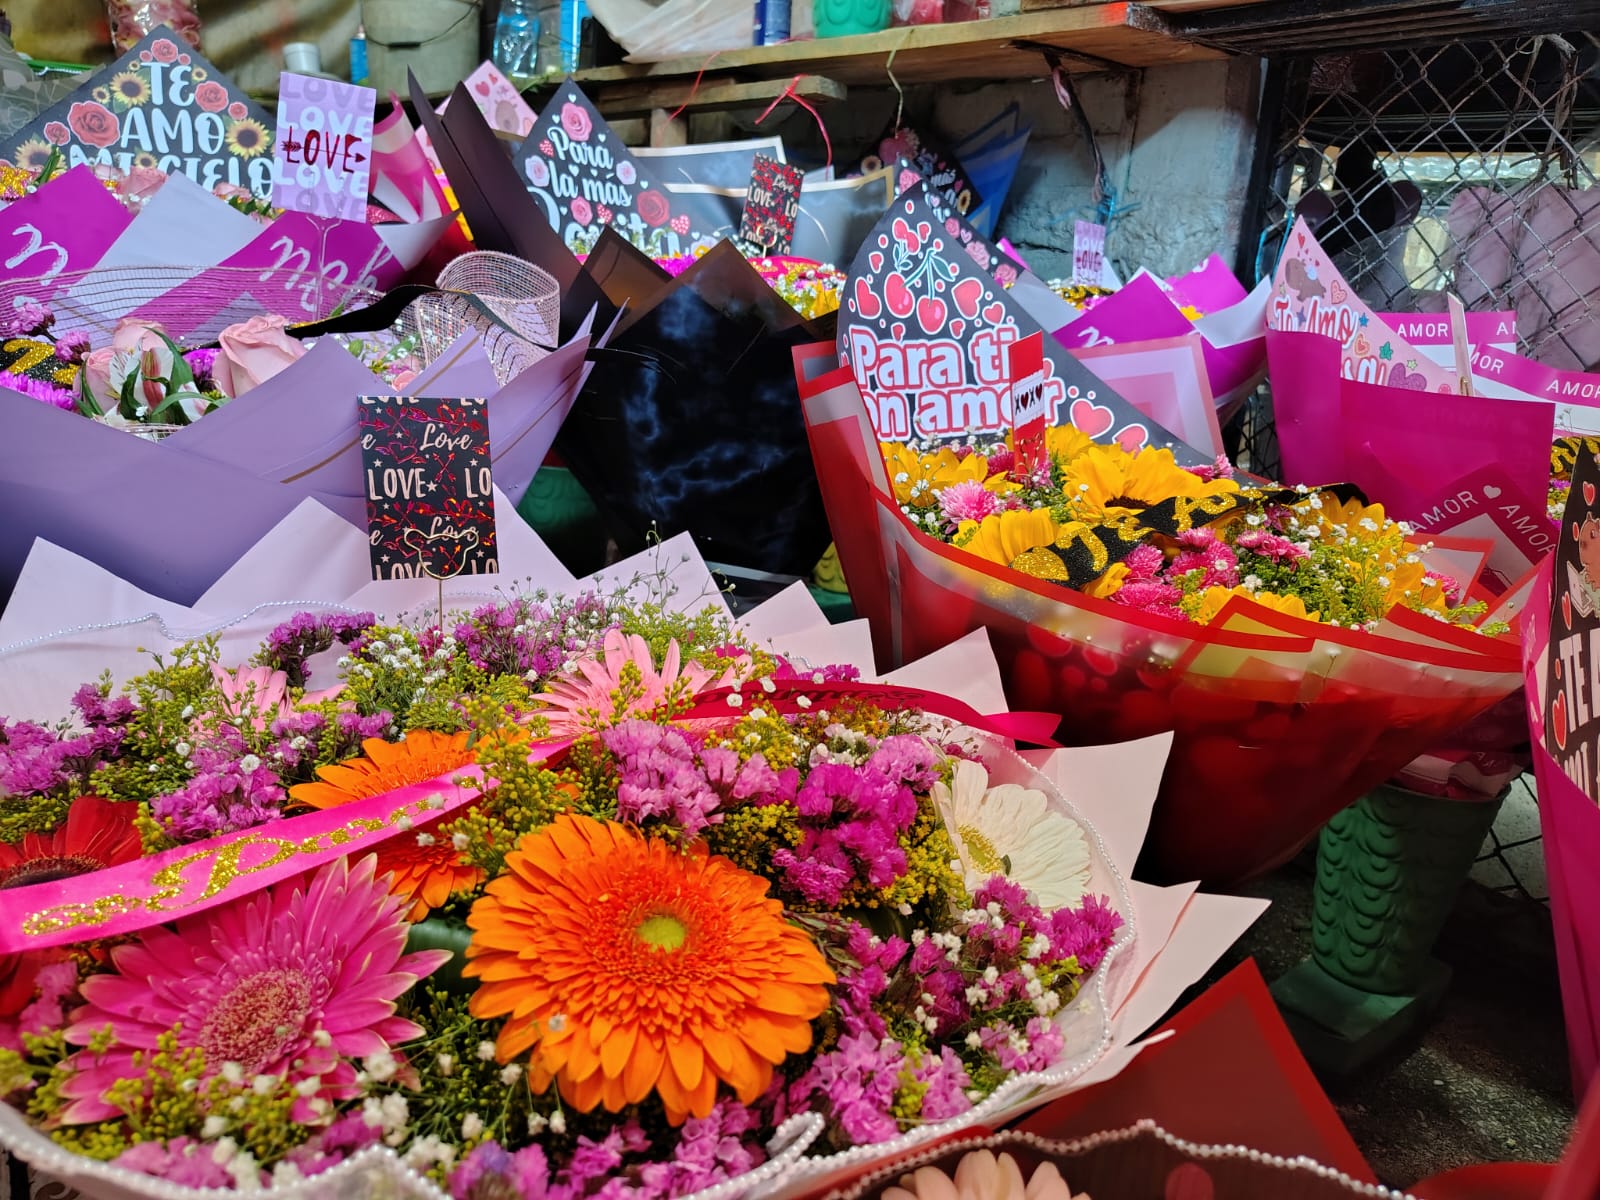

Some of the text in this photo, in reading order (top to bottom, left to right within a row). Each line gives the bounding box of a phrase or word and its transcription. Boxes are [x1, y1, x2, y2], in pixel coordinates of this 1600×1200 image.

[140, 61, 195, 107] TE
[120, 107, 226, 155] AMO
[278, 101, 373, 143] LOVE
[282, 125, 366, 174] LOVE
[546, 126, 614, 169] Para
[273, 156, 369, 199] LOVE
[548, 160, 633, 207] la más
[747, 185, 774, 208] LOVE
[1397, 322, 1449, 338] AMOR
[849, 324, 967, 392] Para
[420, 423, 473, 451] Love
[367, 468, 427, 501] LOVE
[1407, 490, 1479, 533] AMOR
[1559, 632, 1590, 734] TE
